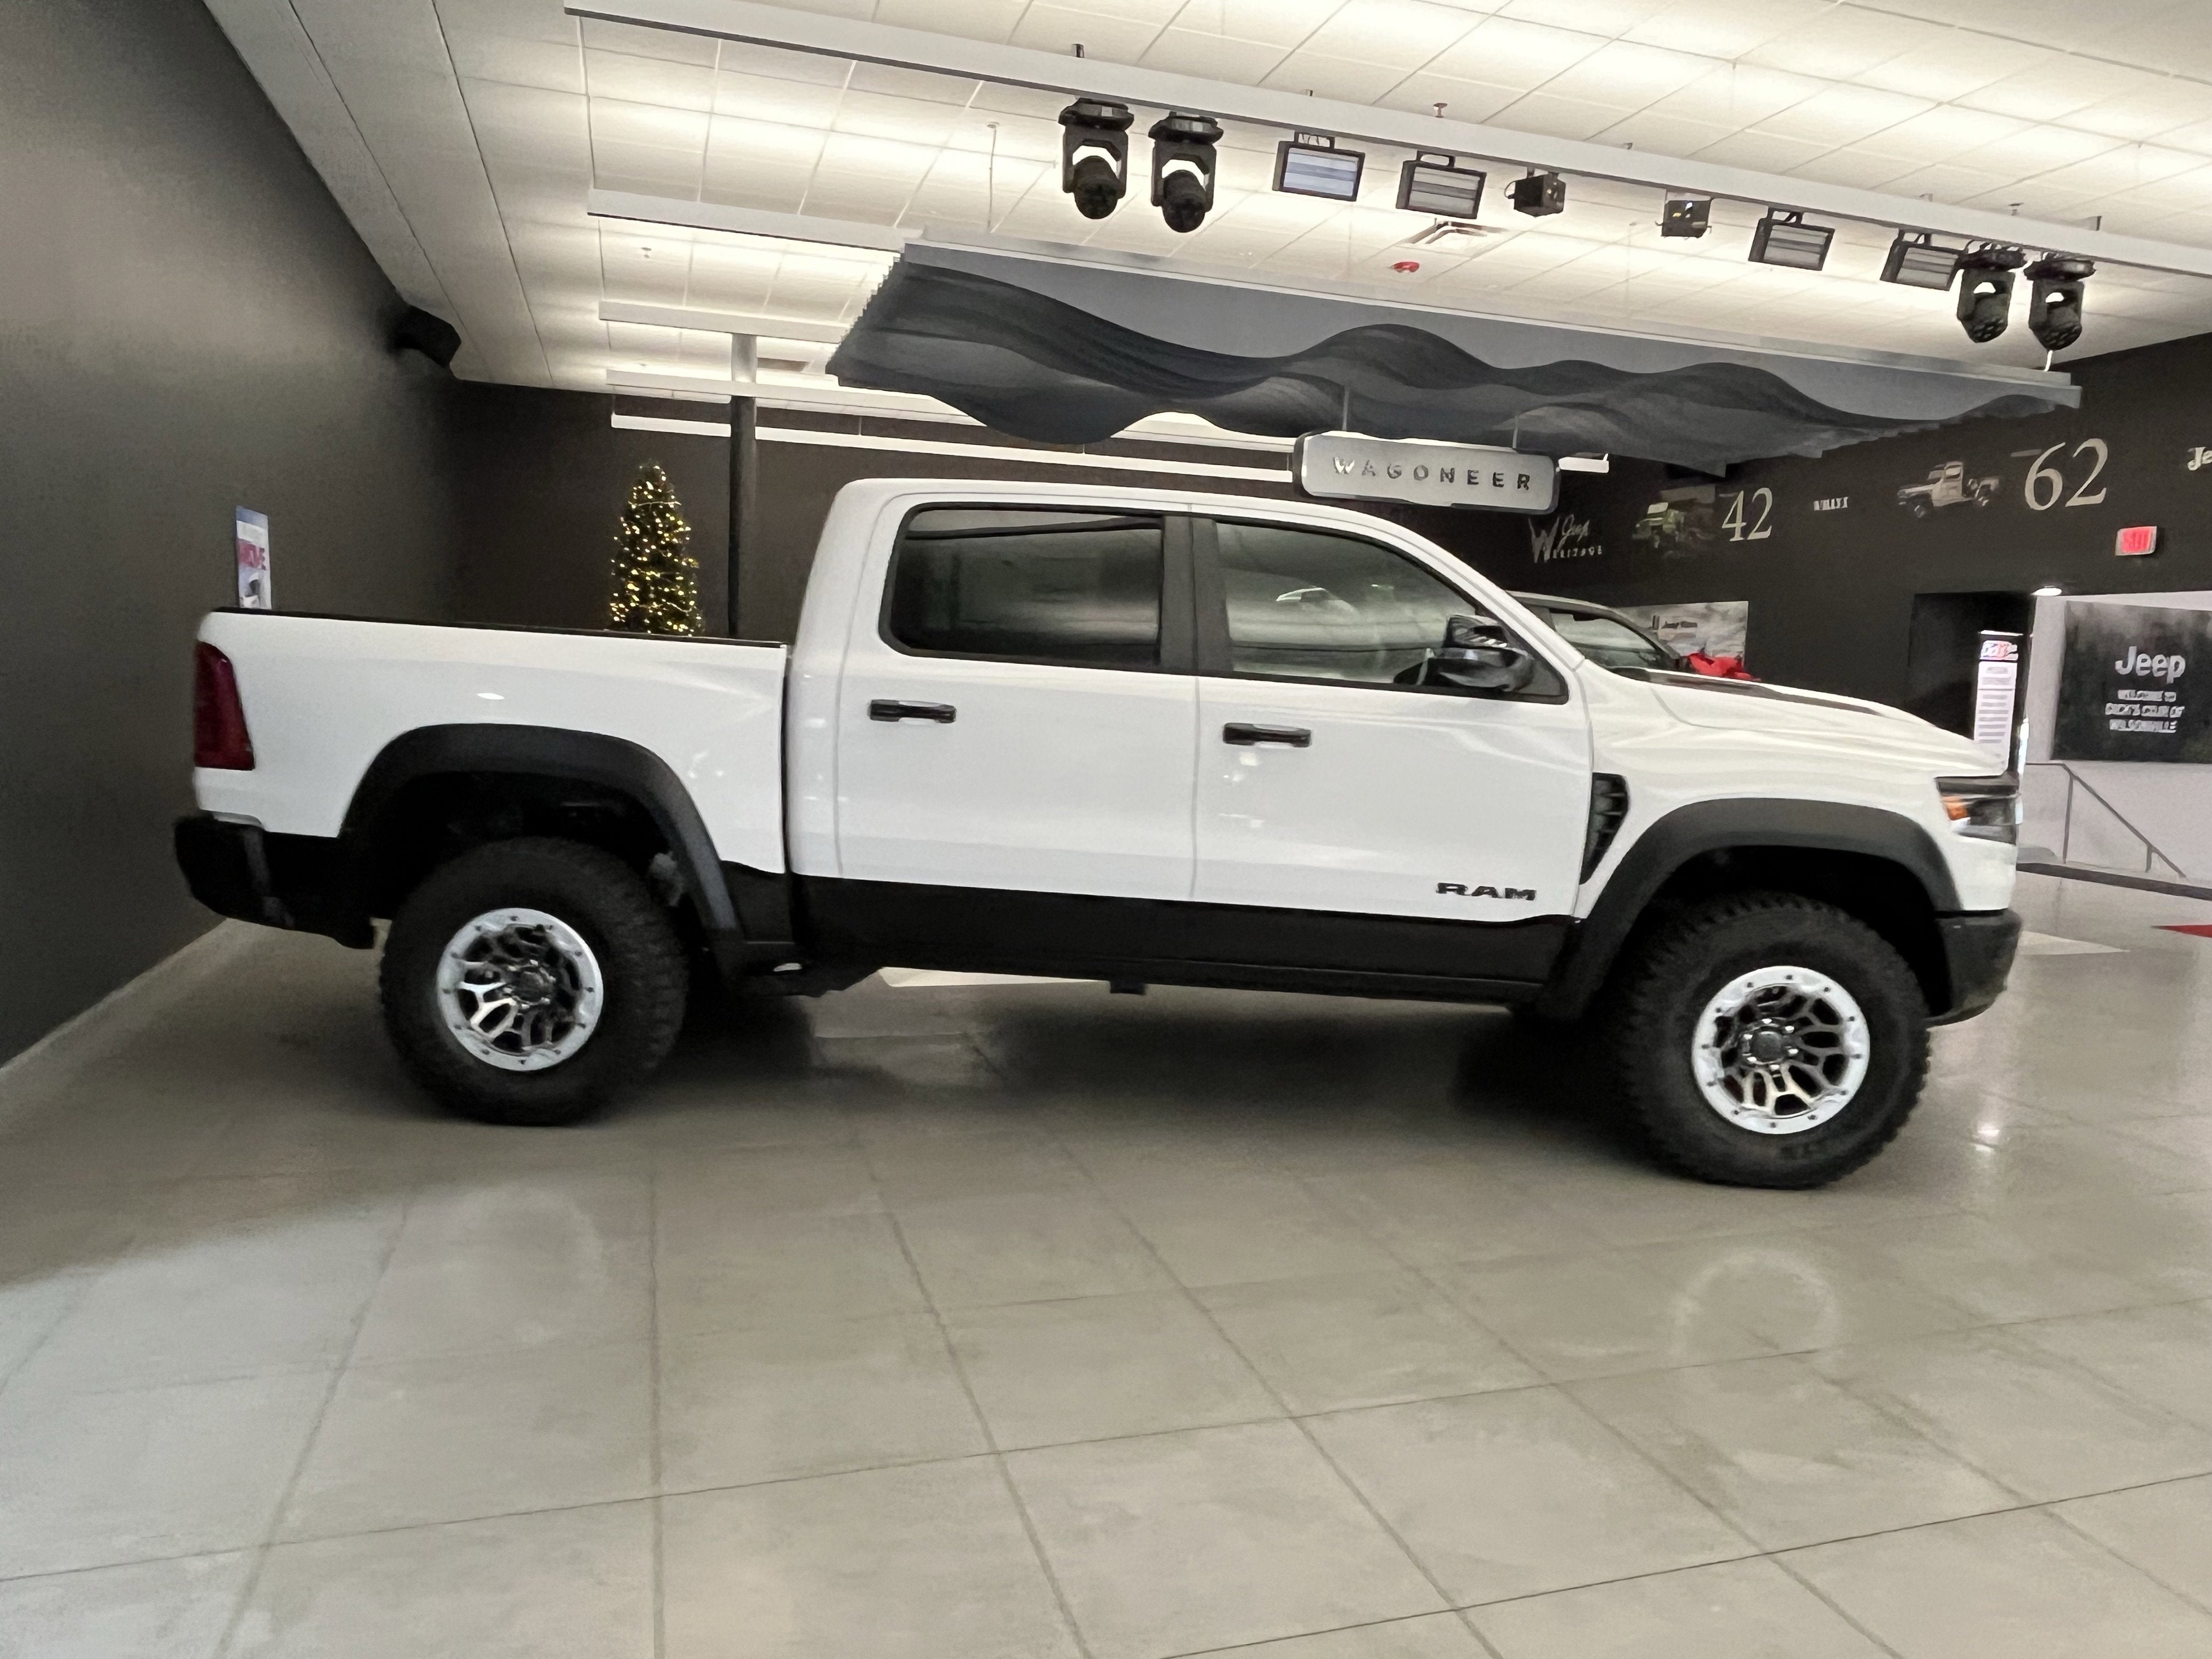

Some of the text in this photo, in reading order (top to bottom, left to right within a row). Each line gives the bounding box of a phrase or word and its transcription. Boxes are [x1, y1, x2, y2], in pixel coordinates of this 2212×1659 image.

[1332, 456, 1531, 491] WAGONEER
[2024, 438, 2108, 511] 62
[1722, 487, 1773, 541] 42
[2115, 646, 2186, 684] Jeep
[1436, 882, 1536, 901] RAM
